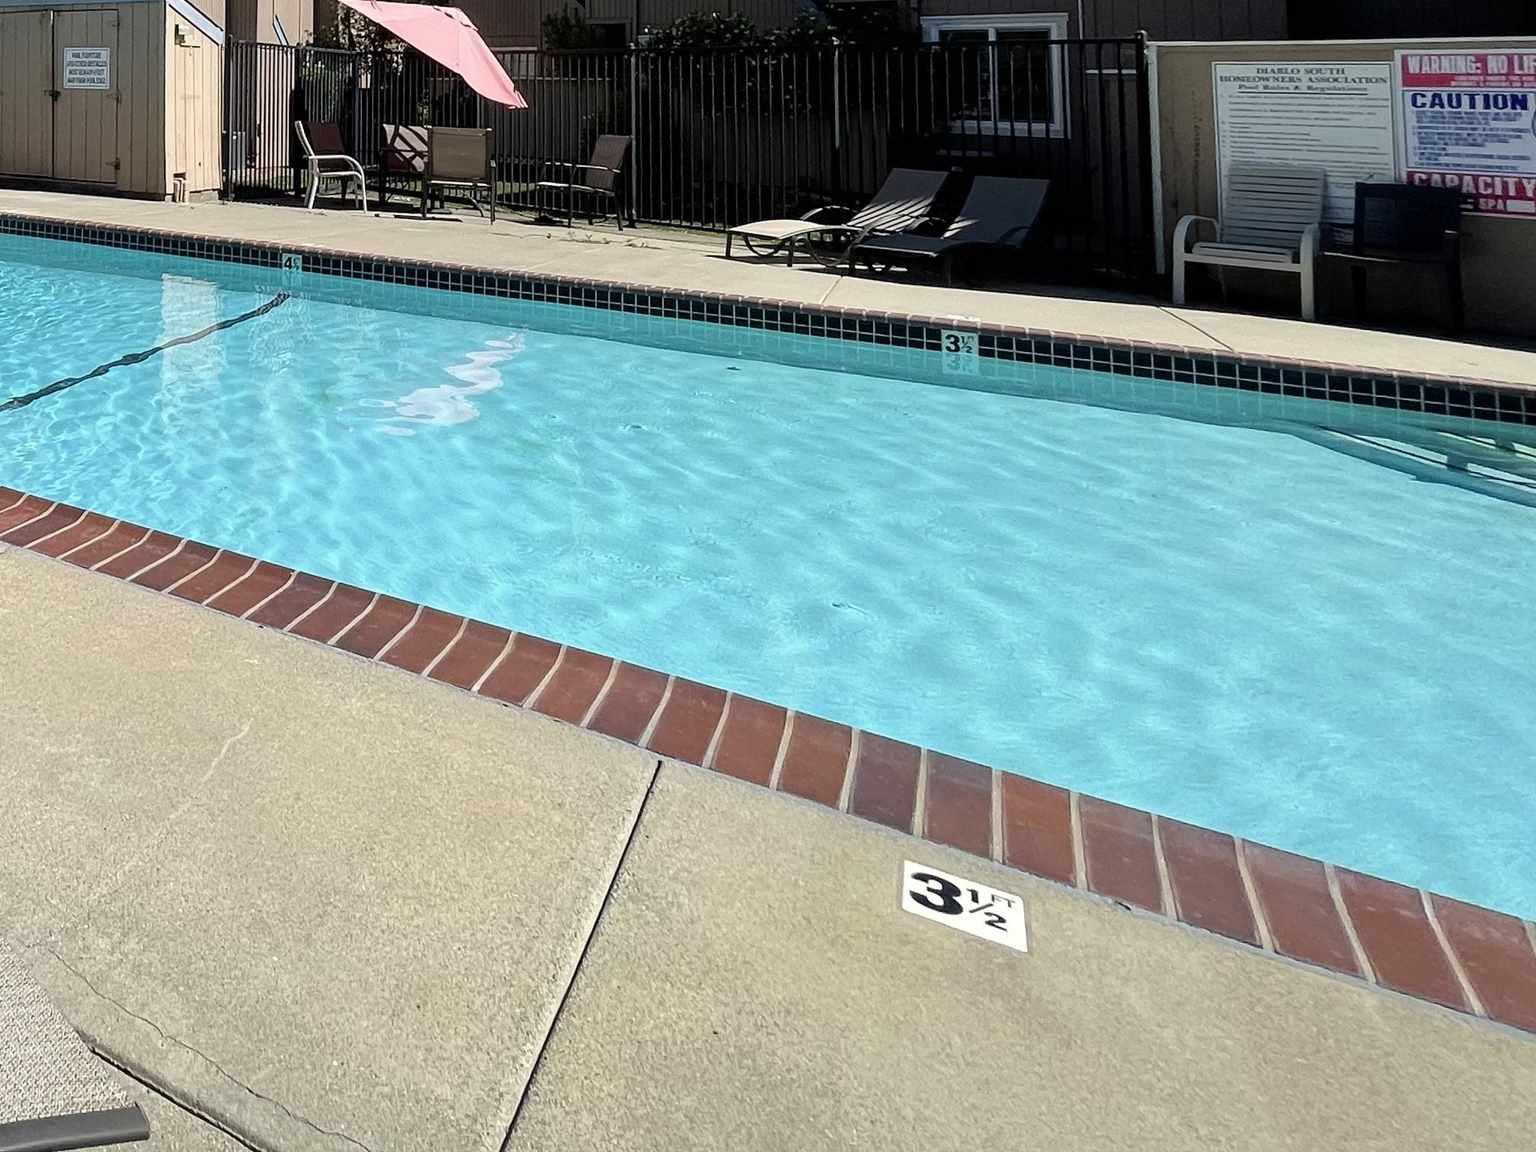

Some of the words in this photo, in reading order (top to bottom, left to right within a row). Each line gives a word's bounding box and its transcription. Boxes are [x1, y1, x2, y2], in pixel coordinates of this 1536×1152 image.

[1256, 67, 1300, 75] DIABLO
[1304, 67, 1346, 75] SOUTH
[1407, 55, 1482, 74] WARNING:
[1487, 55, 1508, 74] NO
[1219, 75, 1303, 84] HOMEOWNERS
[1307, 76, 1388, 85] ASSOCIATION
[1410, 92, 1528, 111] CAUTION
